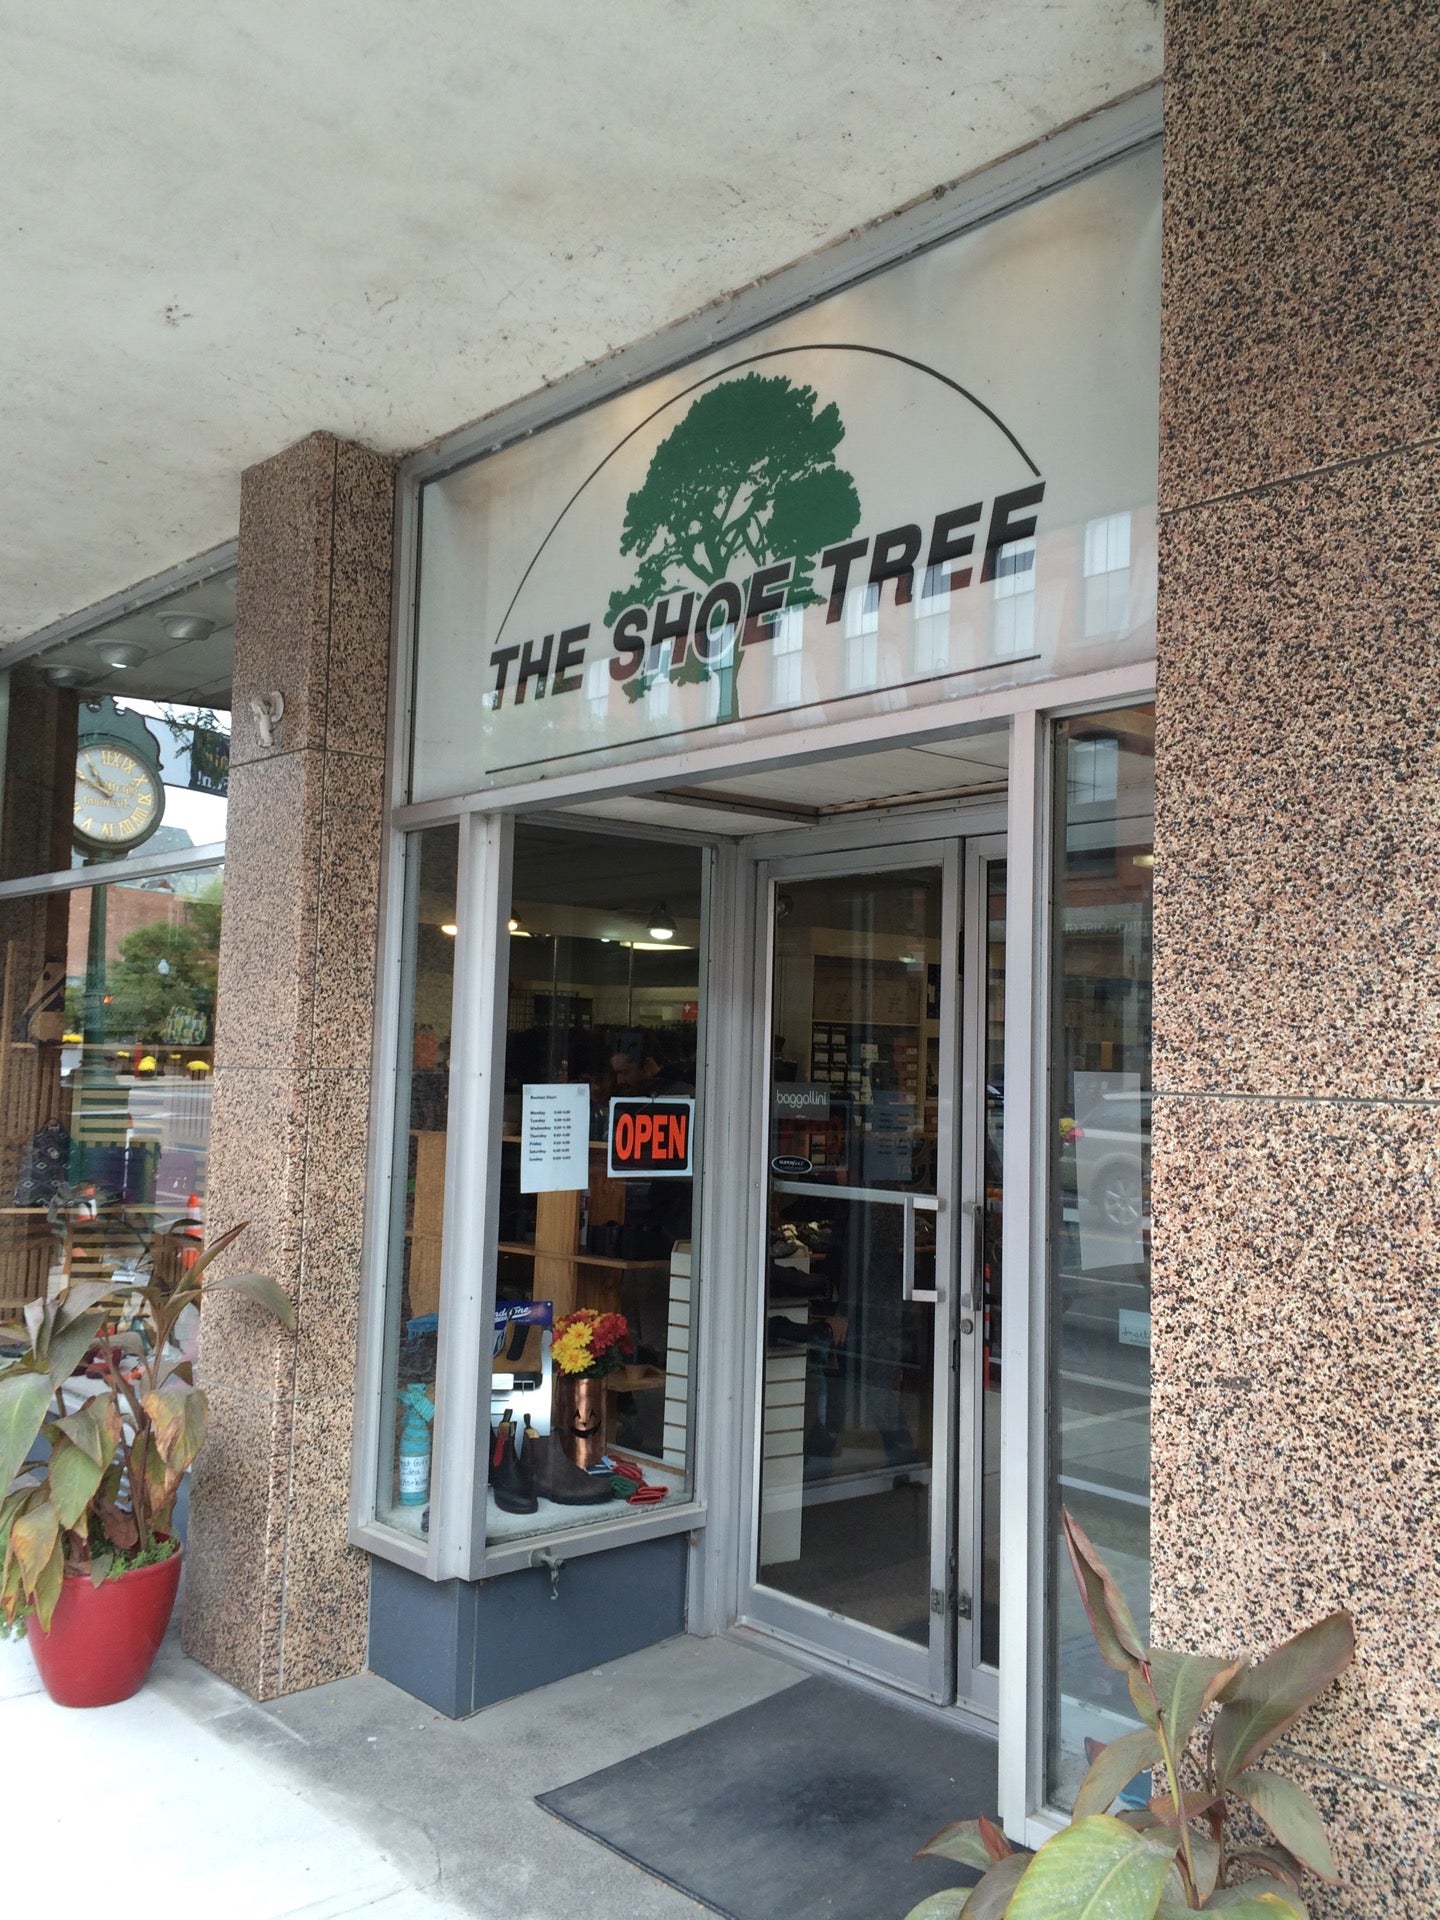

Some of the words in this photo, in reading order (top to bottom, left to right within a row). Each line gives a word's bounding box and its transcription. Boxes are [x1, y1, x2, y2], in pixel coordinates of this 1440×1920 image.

[489, 624, 591, 710] THE
[608, 562, 793, 682] SHOE
[821, 481, 1046, 625] TREE
[615, 1113, 687, 1161] OPEN
